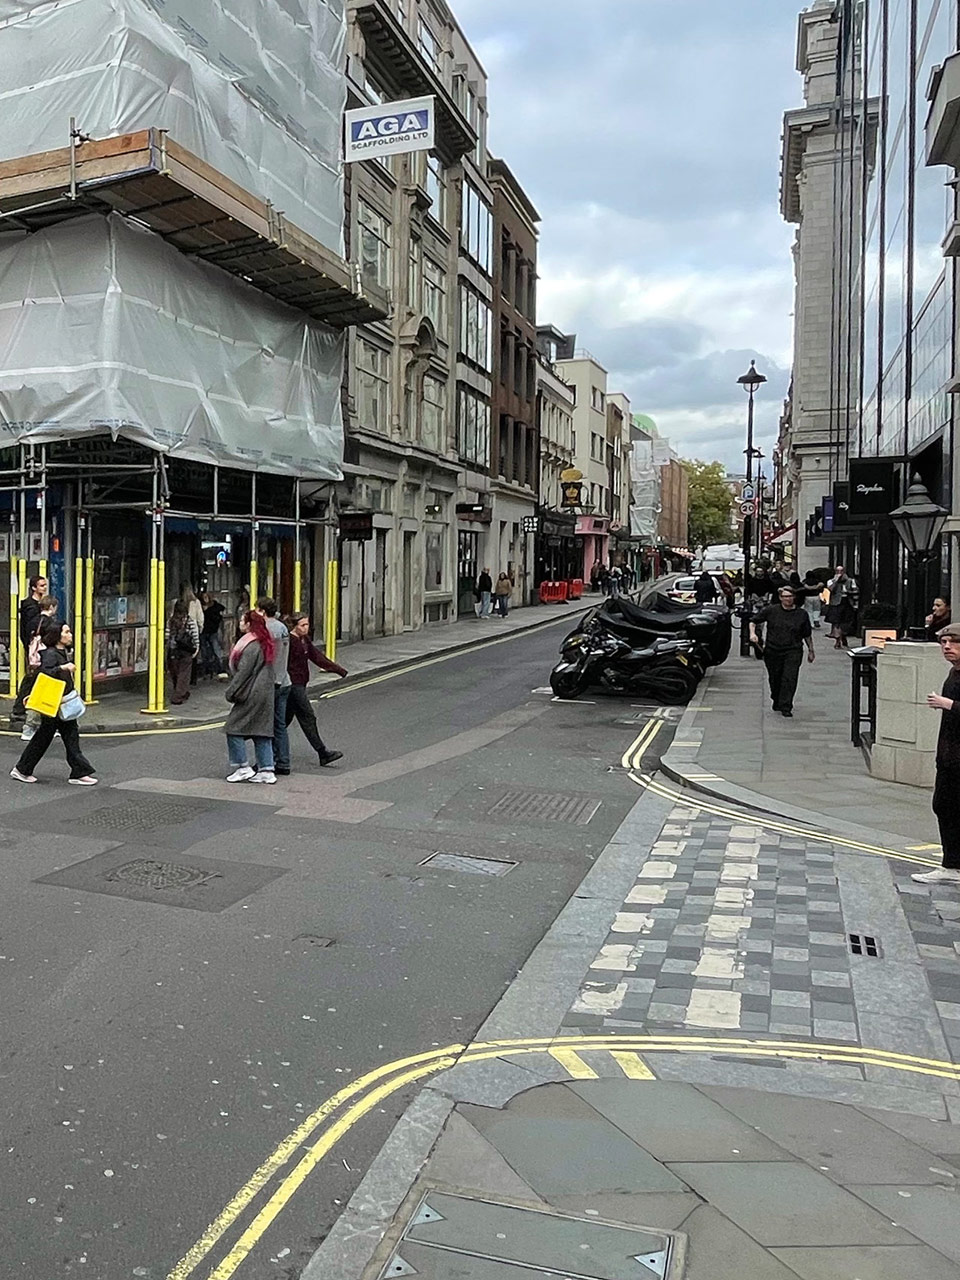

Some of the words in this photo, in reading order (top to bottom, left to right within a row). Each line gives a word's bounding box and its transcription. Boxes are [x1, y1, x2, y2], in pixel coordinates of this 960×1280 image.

[357, 113, 422, 139] AGA
[351, 134, 410, 151] SCAFFOLDING
[412, 132, 429, 141] LTD
